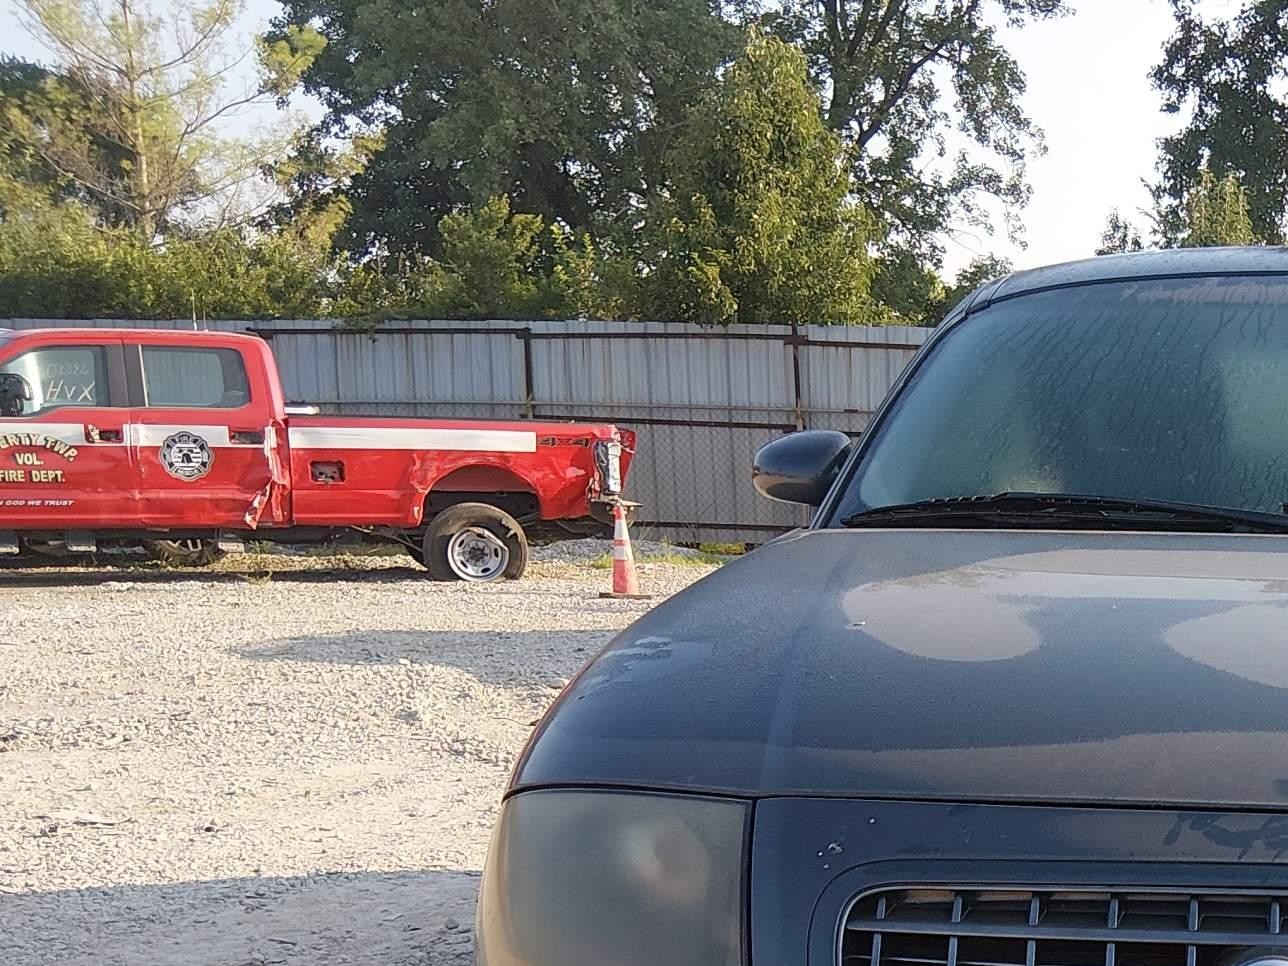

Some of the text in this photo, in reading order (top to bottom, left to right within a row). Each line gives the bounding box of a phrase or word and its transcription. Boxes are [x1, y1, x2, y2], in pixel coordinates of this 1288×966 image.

[44, 435, 78, 461] TWP.
[15, 453, 44, 465] VOL.
[0, 470, 66, 482] FIRE DEPT.
